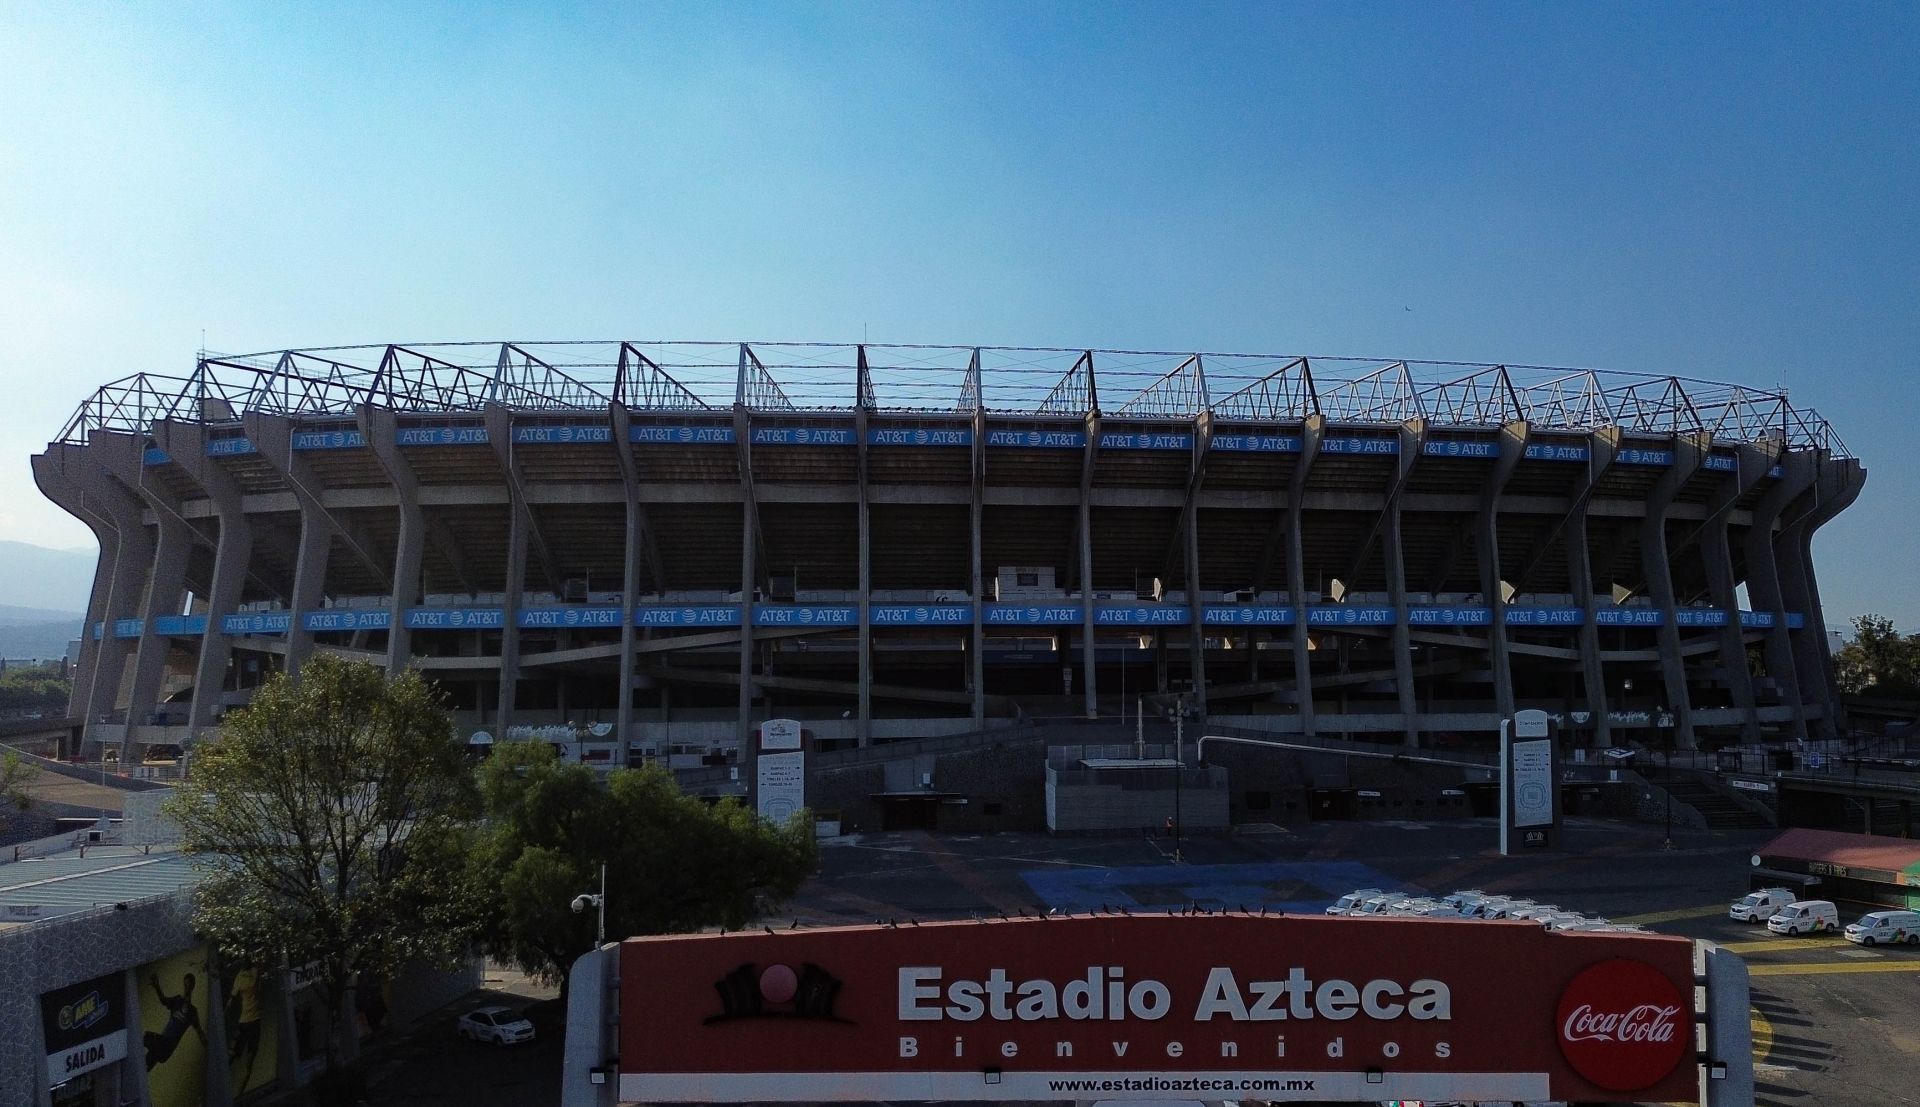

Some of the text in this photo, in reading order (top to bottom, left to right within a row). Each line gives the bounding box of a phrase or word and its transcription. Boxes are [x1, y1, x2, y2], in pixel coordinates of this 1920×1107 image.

[299, 433, 330, 447] AT&T
[402, 430, 436, 443] AT&T
[518, 428, 610, 441] AT&T AT&T
[638, 428, 732, 441] AT&T AT&T
[755, 430, 847, 443] AT&T AT&T
[875, 430, 965, 443] AT&T AT&T
[990, 432, 1077, 446] AT&T AT&T
[212, 441, 237, 453] AT&T
[1101, 435, 1186, 448] AT&T AT&T
[1210, 437, 1292, 450] AT&T AT&T
[1364, 441, 1394, 452] AT&T
[1424, 442, 1490, 455] T&T AT&T
[1525, 445, 1584, 458] &T AT&T
[1642, 452, 1666, 464] AT&T
[1713, 457, 1733, 468] AT&T
[310, 612, 390, 627] AT&T AT&T
[411, 612, 500, 625] AT&T AT&T
[525, 611, 617, 624] AT&T AT&T
[642, 610, 736, 623] AT&T AT&T
[759, 610, 850, 622] AT&T AT&T
[876, 609, 965, 621] AT&T AT&T
[990, 609, 1076, 621] AT&T AT&T
[1099, 609, 1183, 621] AT&T AT&T
[1205, 609, 1287, 622] AT&T AT&T
[1310, 610, 1388, 622] AT&T AT&T
[1409, 610, 1486, 622] AT&T AT&T
[1506, 611, 1577, 623] AT&T AT&T
[1595, 611, 1659, 623] AT&T AT&T
[1703, 612, 1724, 624] AT&T
[225, 616, 290, 630] AT&T AT&T
[898, 966, 1452, 1022] Estadio Azteca
[1564, 1004, 1680, 1042] Coca-Cola
[899, 1035, 1451, 1057] Bienvenidos
[66, 1043, 105, 1073] SALIDA
[1049, 1076, 1315, 1092] www.estadioazteca.com.mx
